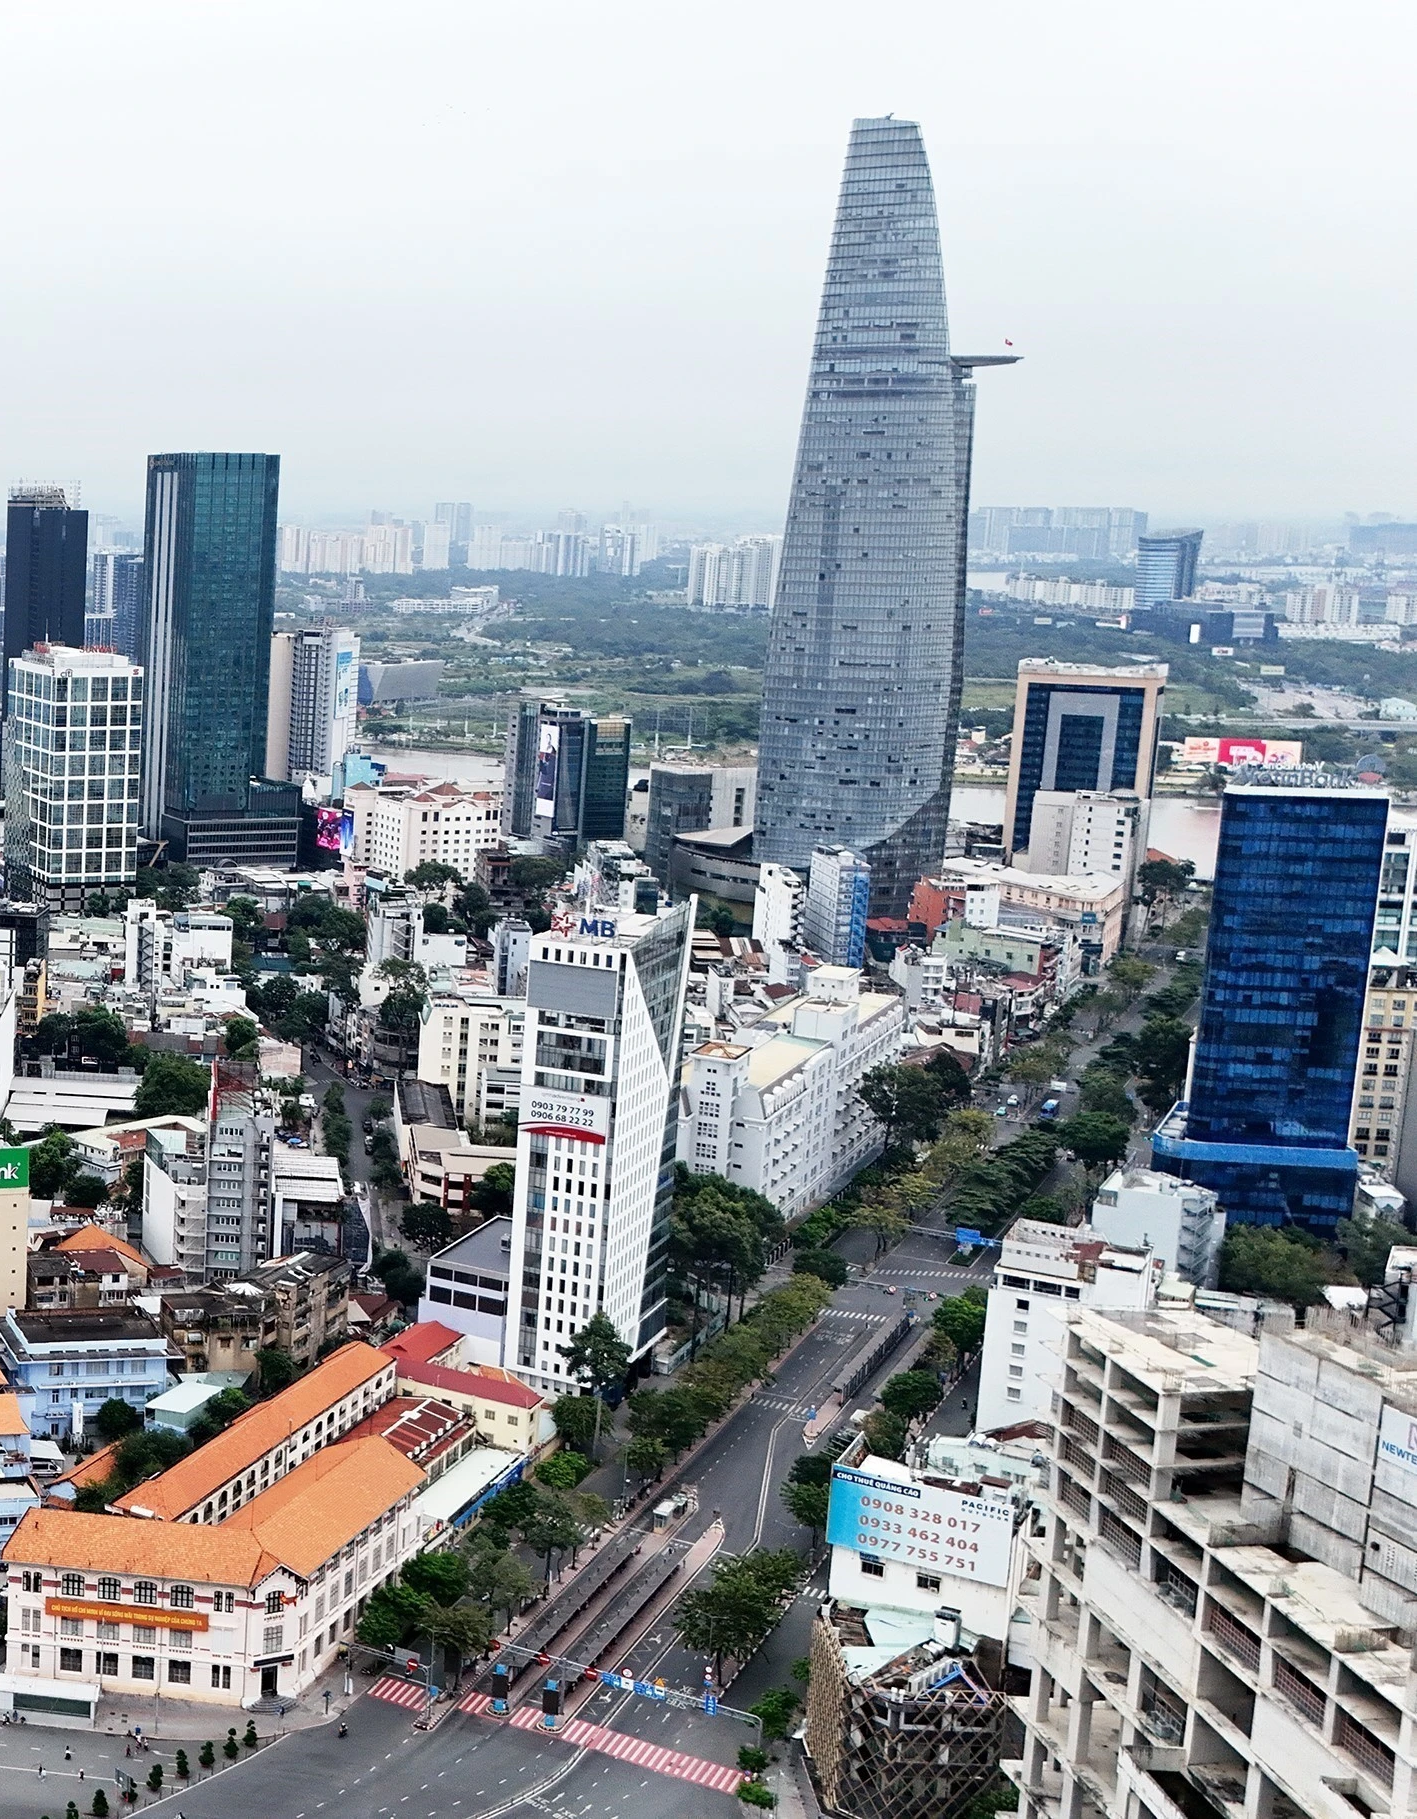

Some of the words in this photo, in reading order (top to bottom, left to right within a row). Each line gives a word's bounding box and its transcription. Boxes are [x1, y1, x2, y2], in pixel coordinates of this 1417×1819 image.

[579, 918, 615, 938] MB
[530, 1110, 553, 1120] 0906
[555, 1114, 567, 1123] 68
[569, 1116, 580, 1125] 22
[582, 1118, 594, 1127] 22
[531, 1100, 554, 1111] 0903
[555, 1104, 567, 1113] 79
[569, 1106, 581, 1115] 77
[582, 1108, 594, 1117] 99
[836, 1472, 853, 1481] CHO
[853, 1475, 874, 1487] THUÊ
[874, 1481, 902, 1493] QUẢNG
[903, 1487, 919, 1497] CÁO
[860, 1496, 904, 1515] 0908
[909, 1507, 942, 1525] 328
[947, 1517, 981, 1533] 017
[962, 1500, 1009, 1516] PACIFIC
[858, 1514, 902, 1534] 0933
[907, 1527, 940, 1544] 462
[945, 1536, 979, 1553] 404
[857, 1533, 901, 1552] 0977
[906, 1545, 939, 1562] 755
[944, 1555, 976, 1572] 751
